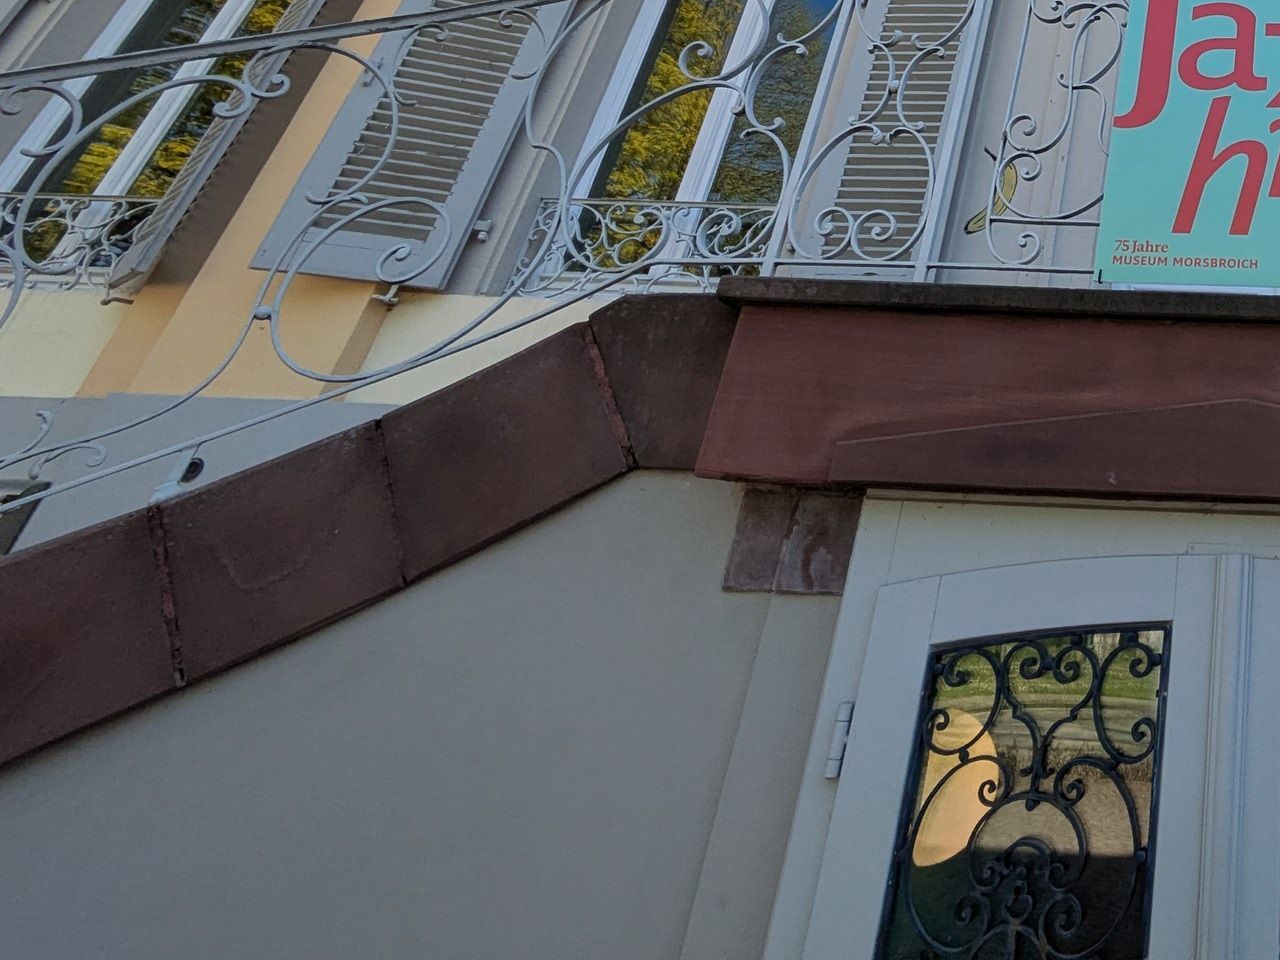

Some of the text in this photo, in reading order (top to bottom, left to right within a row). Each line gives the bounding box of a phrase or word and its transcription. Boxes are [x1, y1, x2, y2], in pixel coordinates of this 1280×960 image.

[1114, 240, 1169, 253] 75 Jahre
[1112, 255, 1259, 269] MUSEUM MORSBROICH
